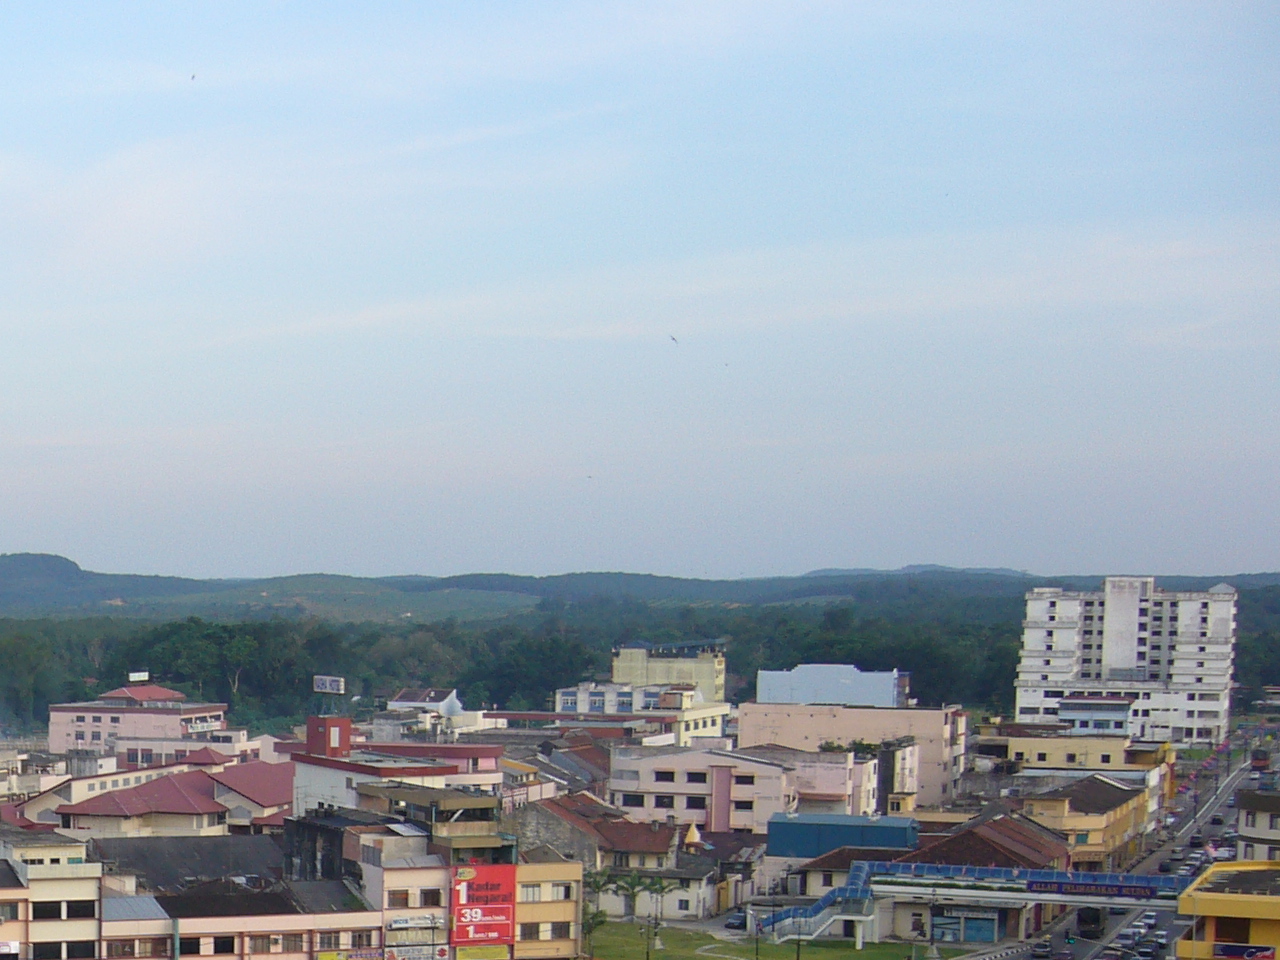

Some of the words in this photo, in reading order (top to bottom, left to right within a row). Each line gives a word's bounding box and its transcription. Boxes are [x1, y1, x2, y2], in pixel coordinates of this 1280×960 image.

[455, 881, 468, 904] 1
[468, 882, 501, 892] Kadar
[461, 908, 482, 922] 39
[466, 925, 475, 938] 1
